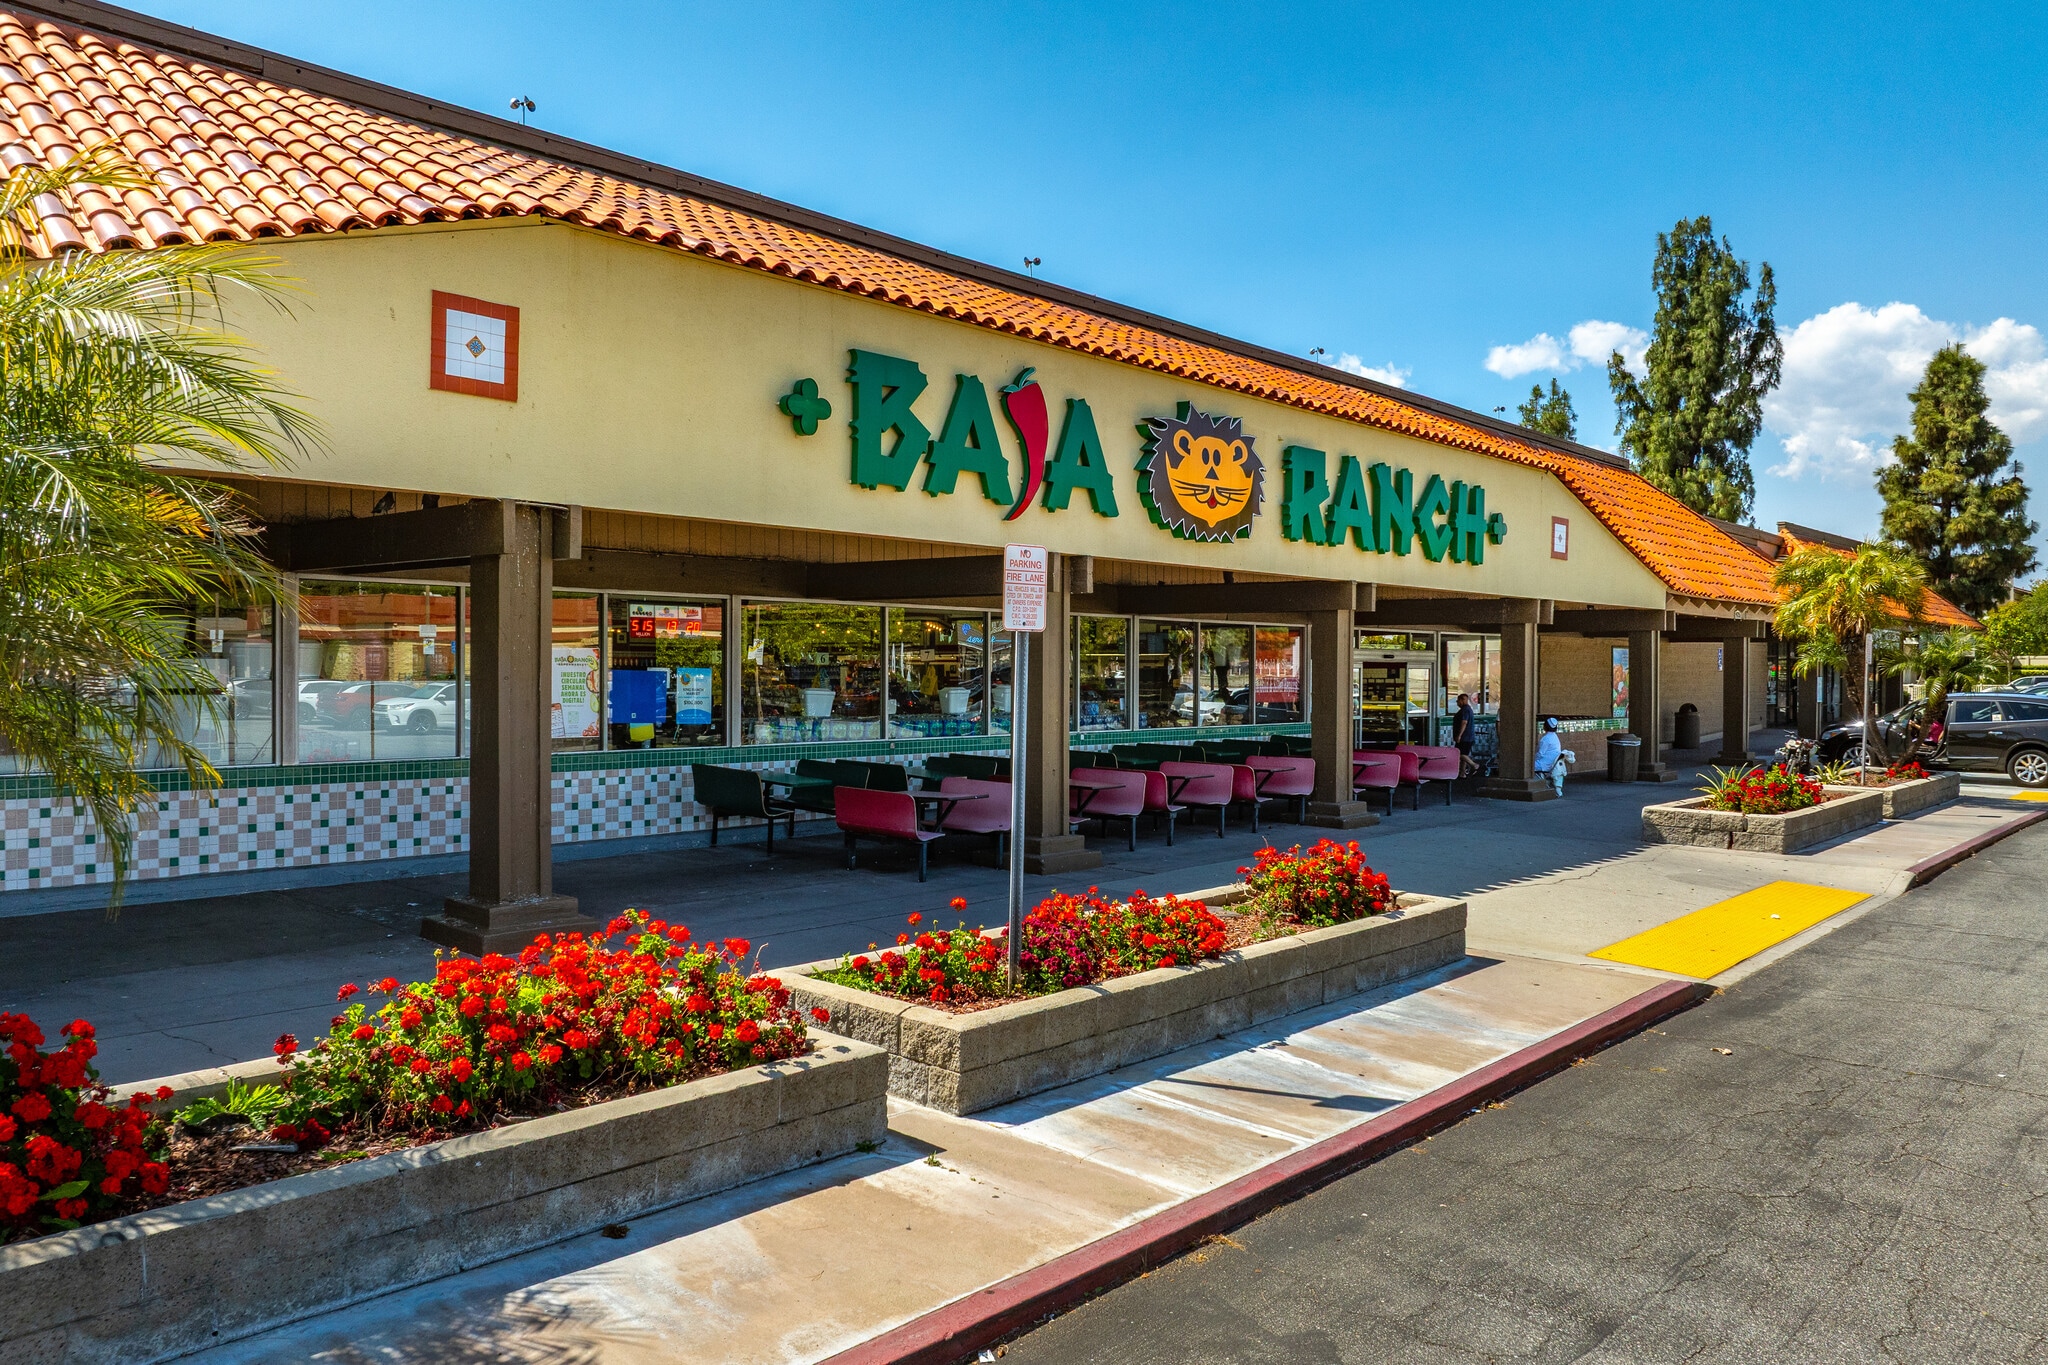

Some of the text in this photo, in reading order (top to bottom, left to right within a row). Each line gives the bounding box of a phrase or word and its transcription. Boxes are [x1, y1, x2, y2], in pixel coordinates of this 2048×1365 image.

[846, 347, 1486, 566] BAJA RANCH
[1020, 549, 1031, 559] NO
[1009, 559, 1042, 569] PARKING
[1006, 572, 1044, 583] FIRE LANE
[666, 621, 677, 633] 13
[686, 621, 701, 633] 20
